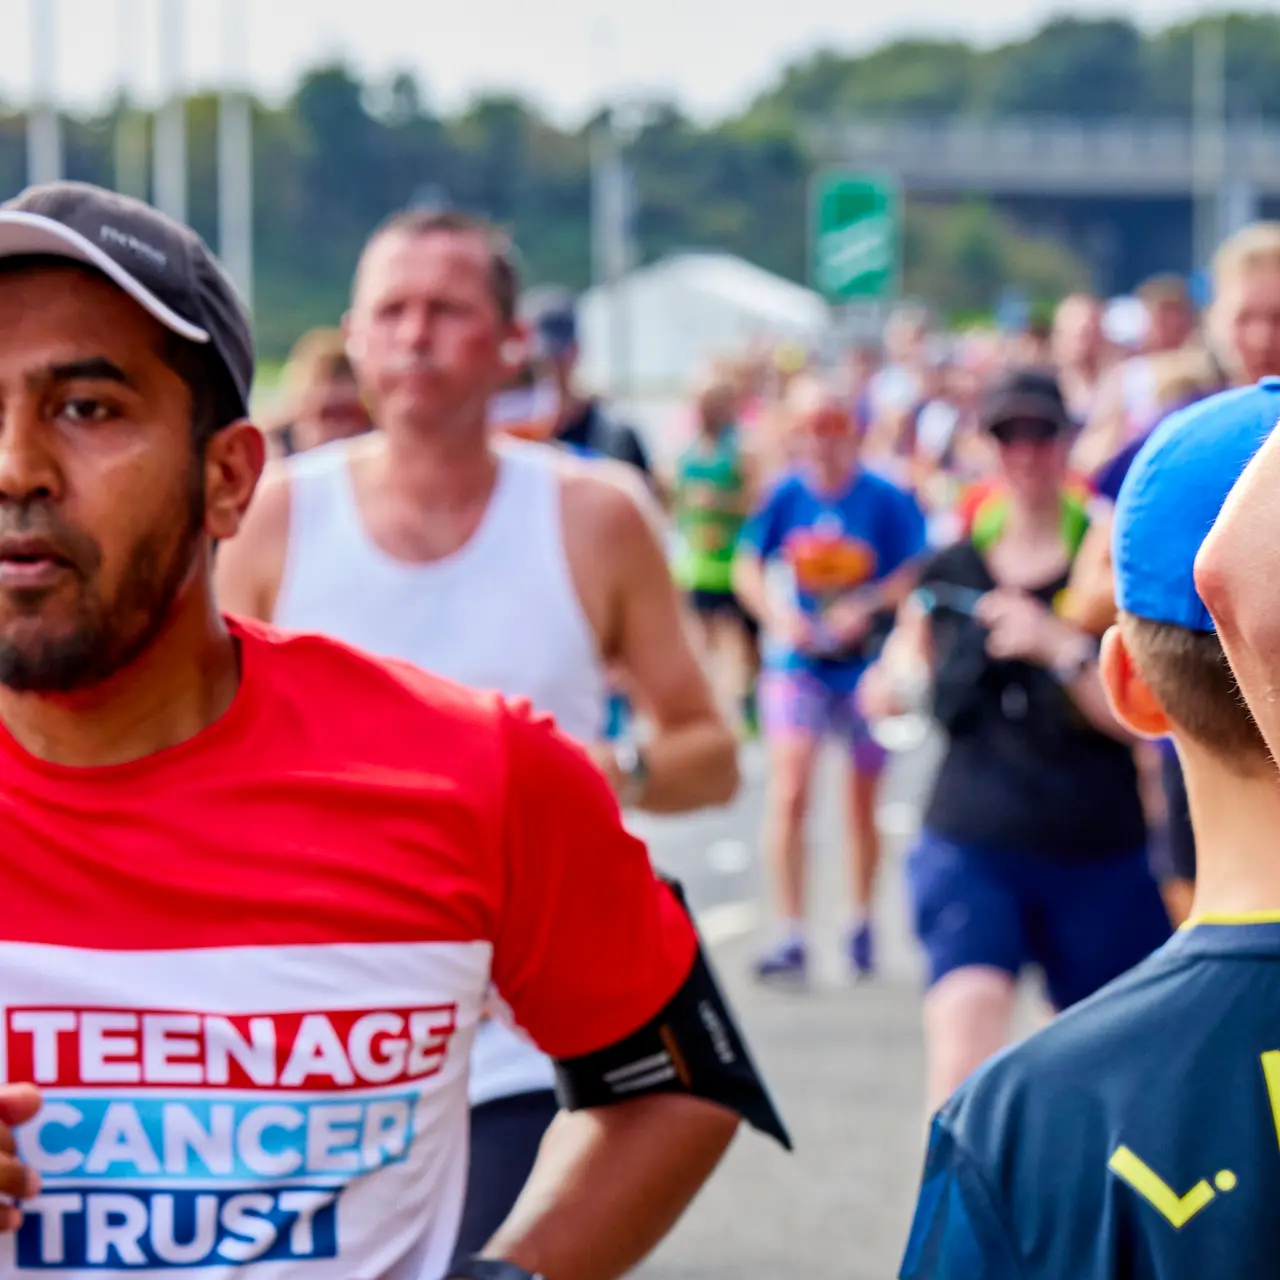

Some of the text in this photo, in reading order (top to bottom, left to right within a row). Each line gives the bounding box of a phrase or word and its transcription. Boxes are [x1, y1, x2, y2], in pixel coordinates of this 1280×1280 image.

[10, 1008, 455, 1086] TEENAGE
[16, 1101, 414, 1176] CANCER
[1107, 1143, 1237, 1229] L.
[23, 1190, 338, 1265] TRUST
